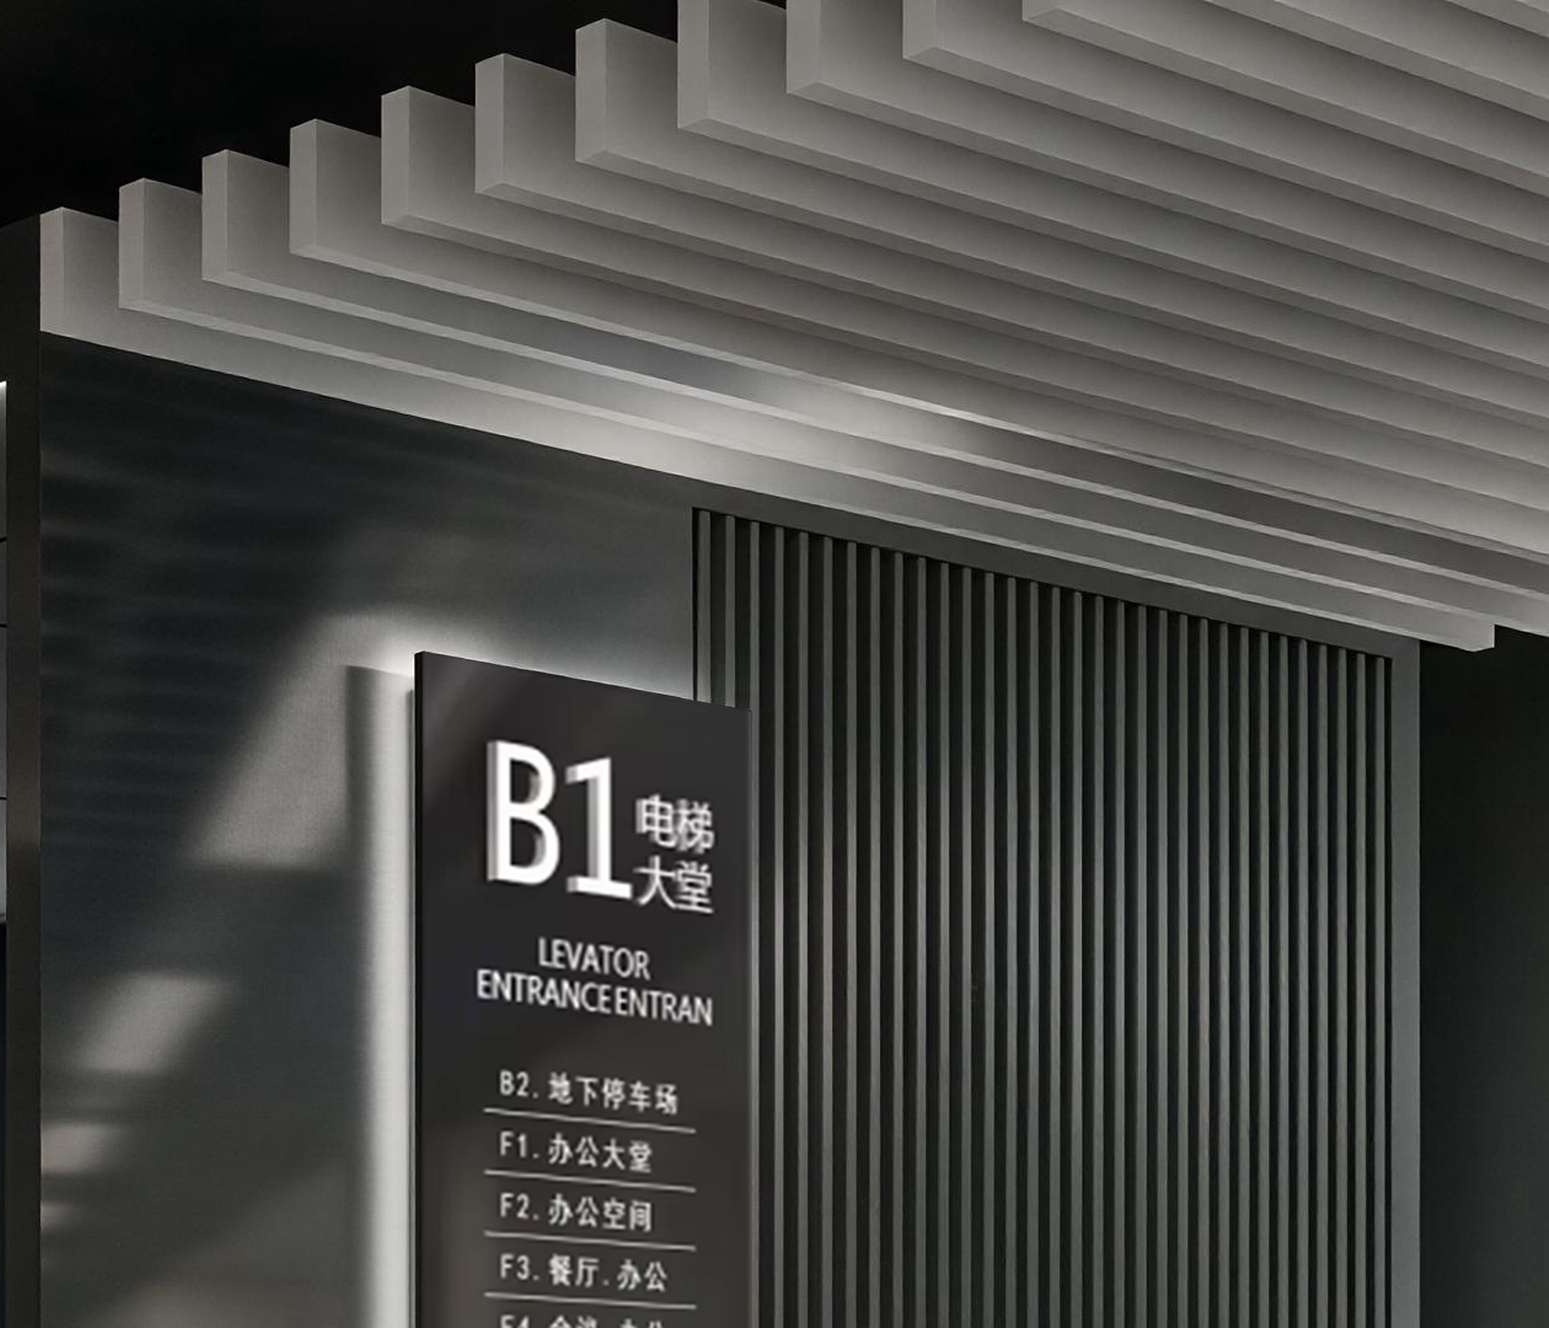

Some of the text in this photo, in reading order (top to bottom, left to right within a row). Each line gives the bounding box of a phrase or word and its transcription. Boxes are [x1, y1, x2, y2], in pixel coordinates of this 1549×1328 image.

[486, 739, 633, 899] B1
[635, 794, 715, 854] 电梯
[634, 855, 714, 914] 大堂
[538, 937, 650, 980] LEVATOR
[477, 969, 713, 1026] ENTRANCE ENTRAN
